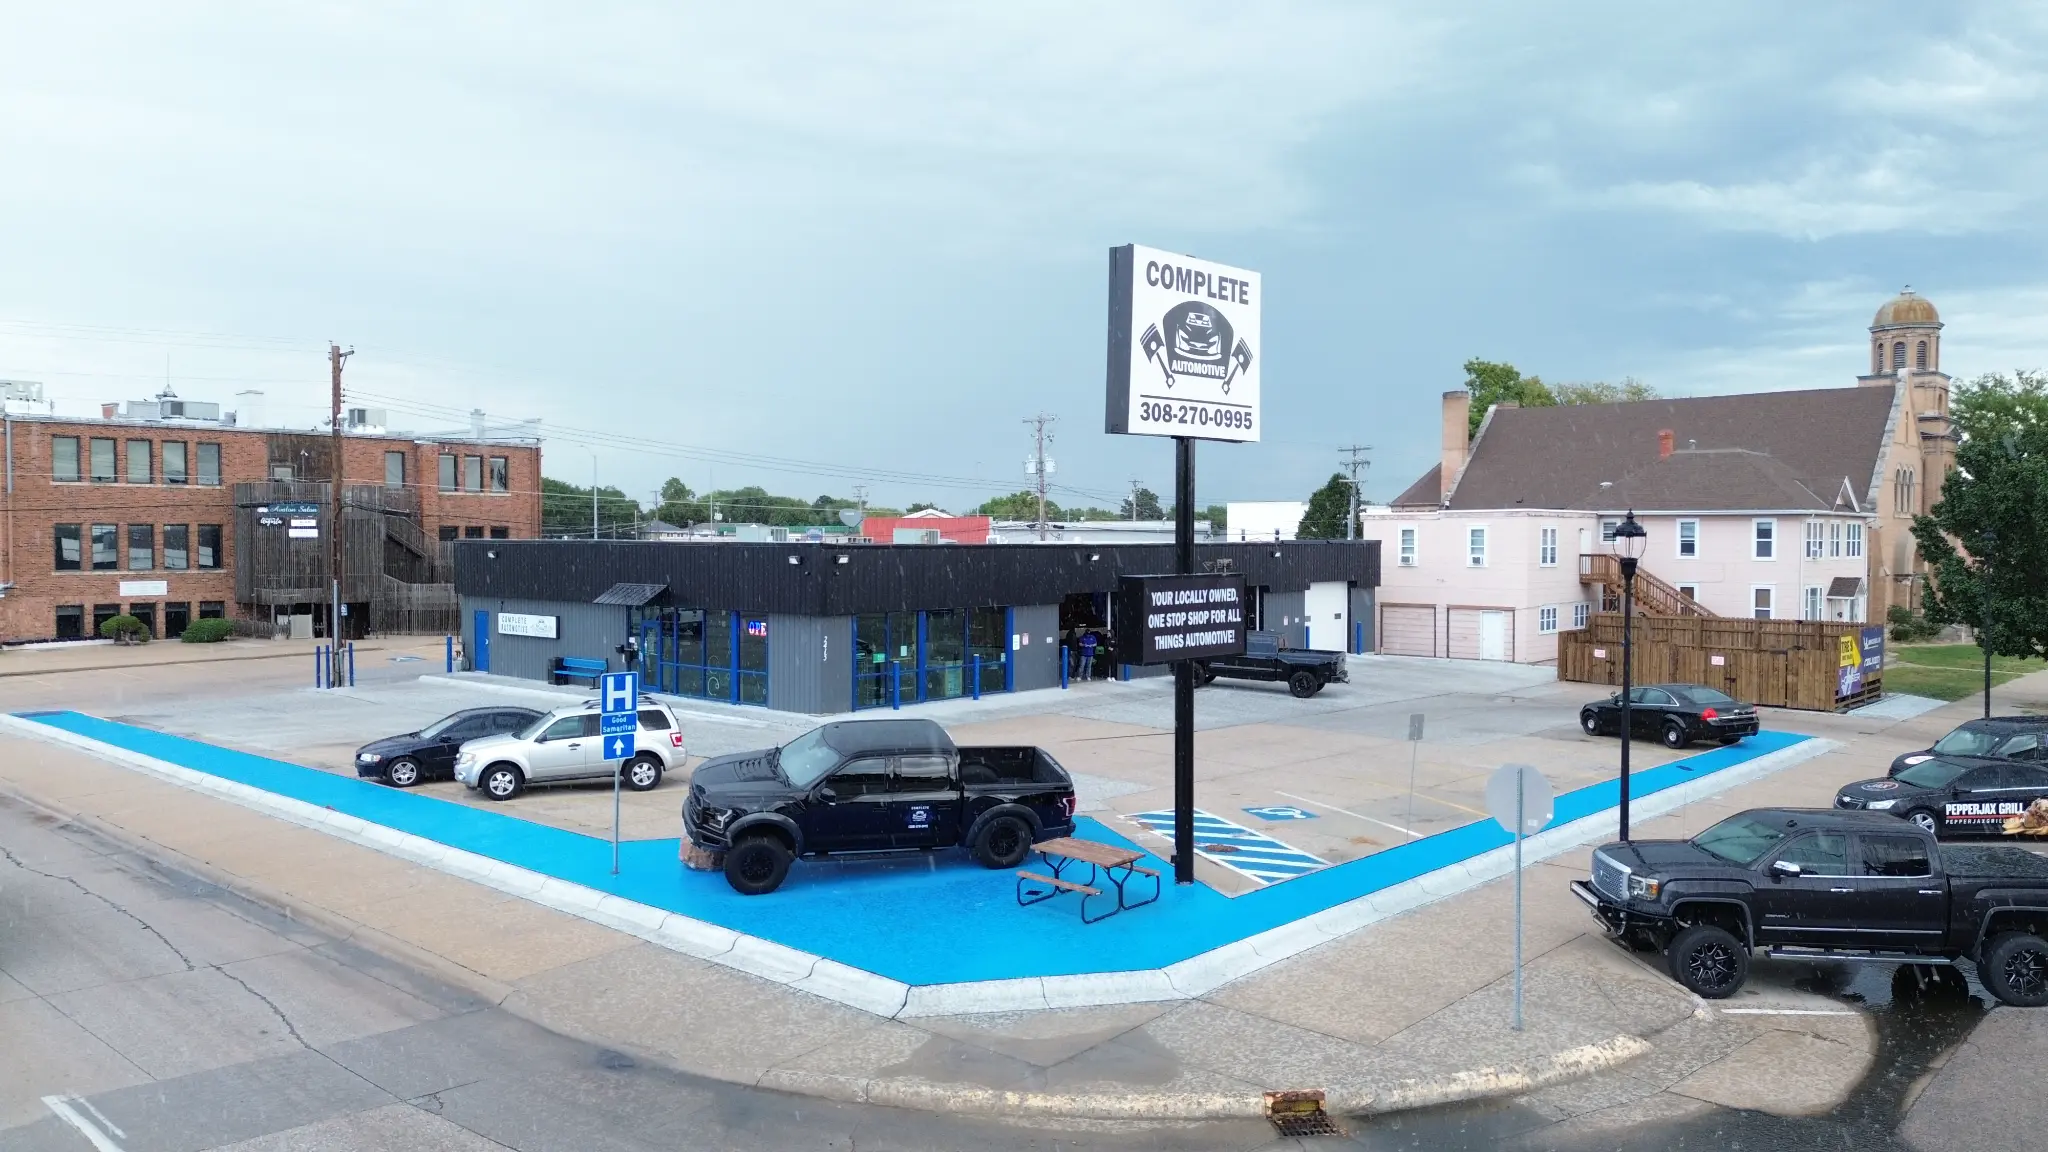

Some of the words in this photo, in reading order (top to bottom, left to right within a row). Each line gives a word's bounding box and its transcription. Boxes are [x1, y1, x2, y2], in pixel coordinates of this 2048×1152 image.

[1146, 260, 1249, 305] COMPLETE
[1171, 359, 1226, 378] AUTOMOTIVE
[1139, 401, 1253, 430] 308-270-0995
[298, 504, 318, 513] Salon
[1151, 591, 1174, 606] YOUR
[1175, 589, 1208, 605] LOCALLY
[1208, 588, 1239, 604] OWNED,
[501, 615, 527, 625] COMPLETE
[1148, 612, 1165, 628] ONE
[1166, 611, 1187, 627] STOP
[1188, 610, 1209, 626] SHOP
[1210, 609, 1226, 623] FOR
[1227, 608, 1242, 622] ALL
[748, 621, 767, 636] OPE
[1154, 632, 1184, 650] THINGS
[1185, 629, 1235, 648] AUTOMOTIVE!
[606, 674, 633, 712] H
[602, 723, 636, 734] Samaritan
[611, 716, 627, 724] Good
[1945, 802, 1996, 816] PEPPERJAX
[1998, 802, 2024, 815] GRILL
